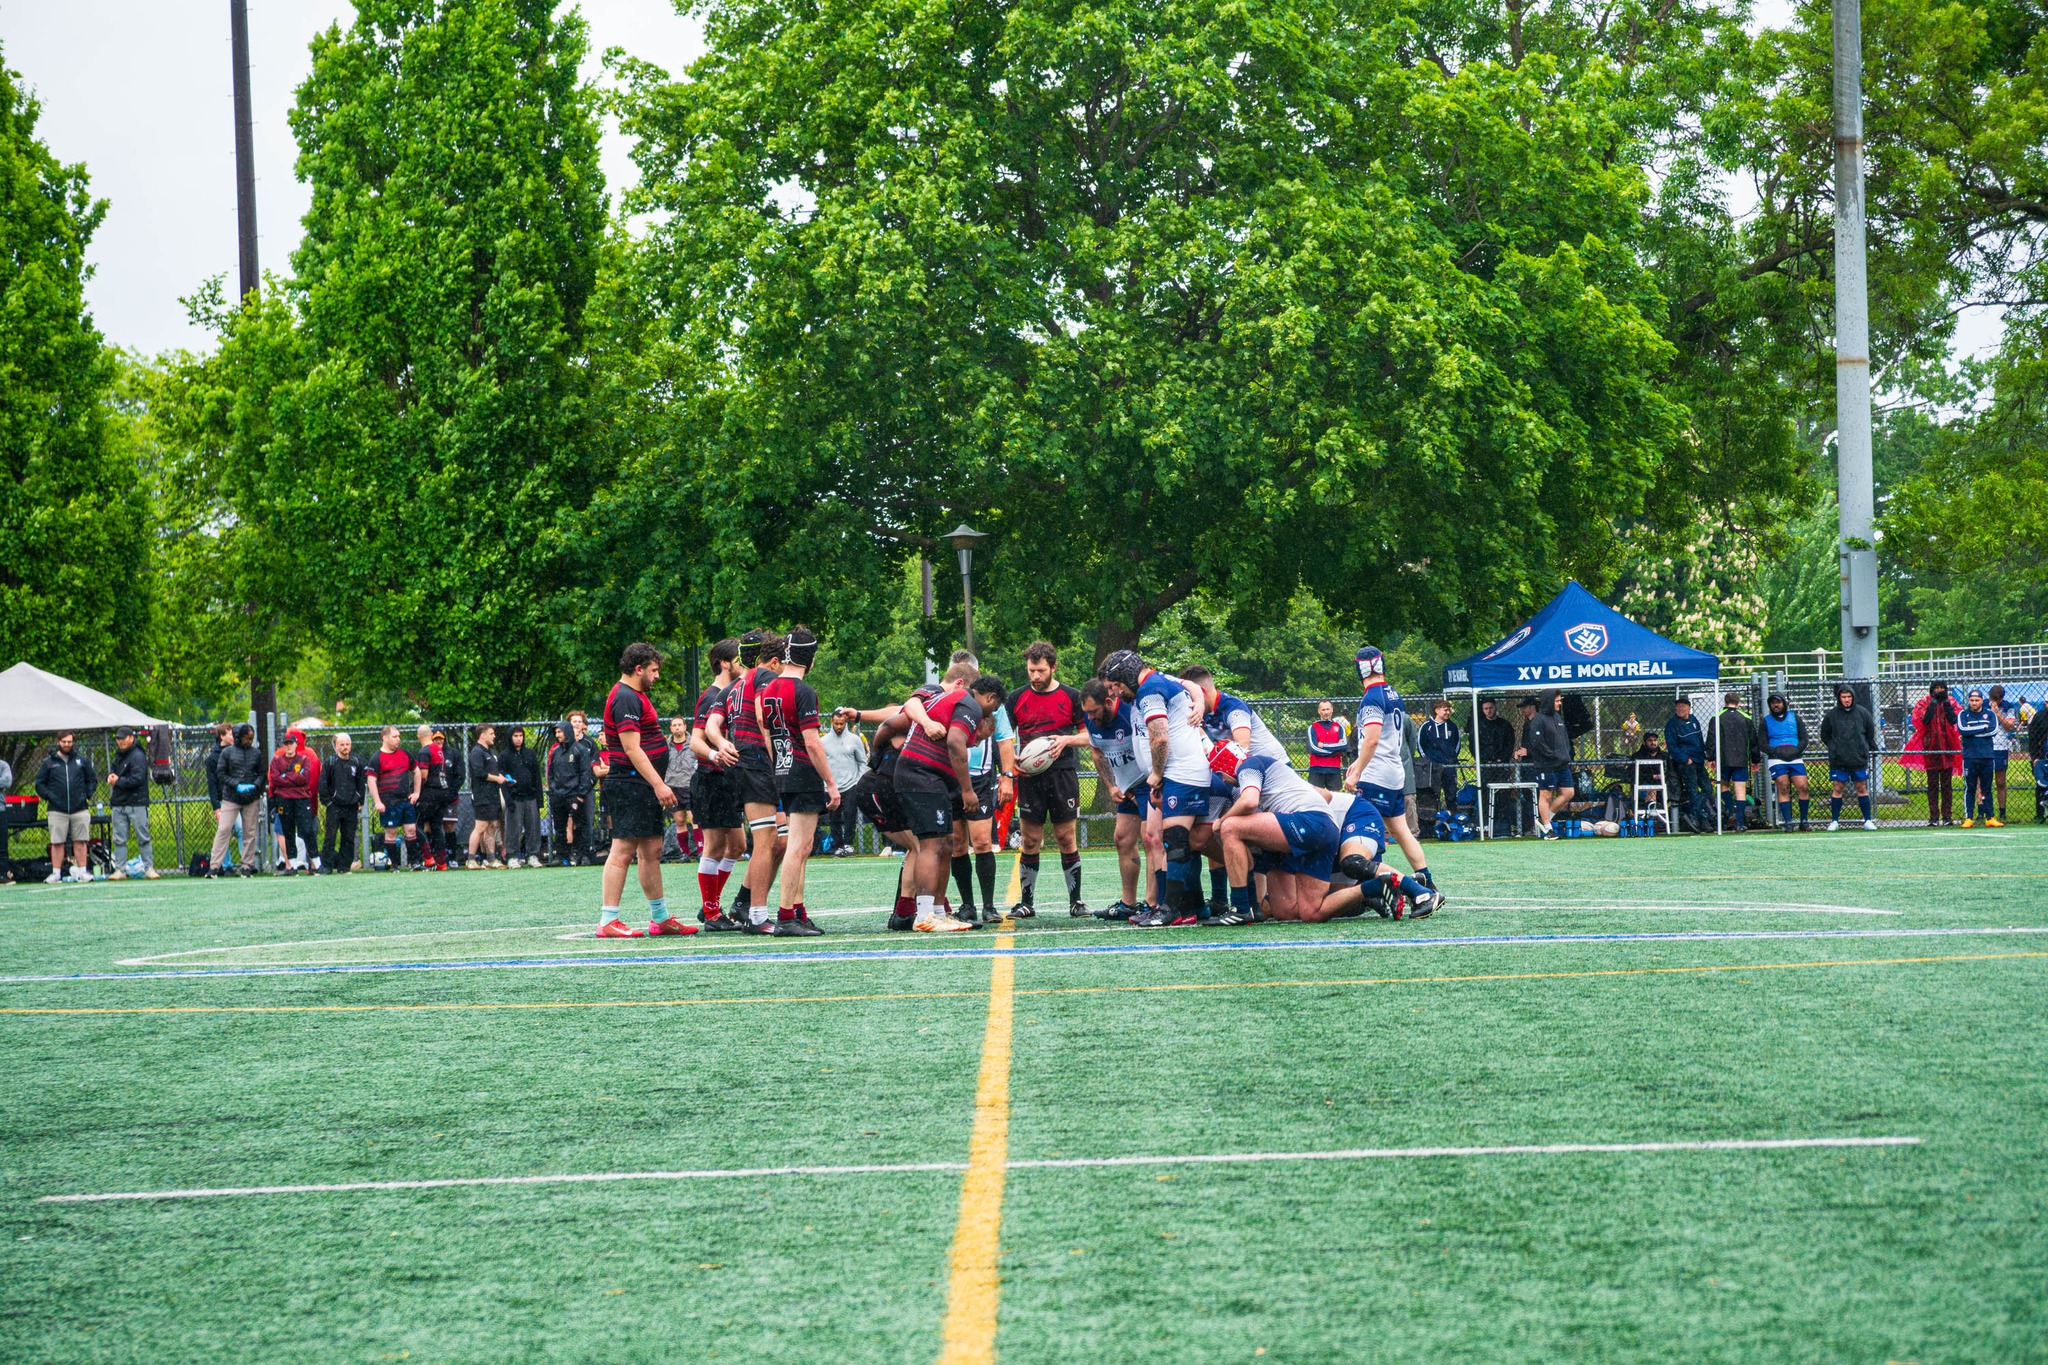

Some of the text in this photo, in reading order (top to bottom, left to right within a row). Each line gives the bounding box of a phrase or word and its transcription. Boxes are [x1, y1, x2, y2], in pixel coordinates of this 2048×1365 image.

[1517, 667, 1543, 681] XV
[1549, 665, 1573, 679] DE
[763, 697, 790, 737] 21
